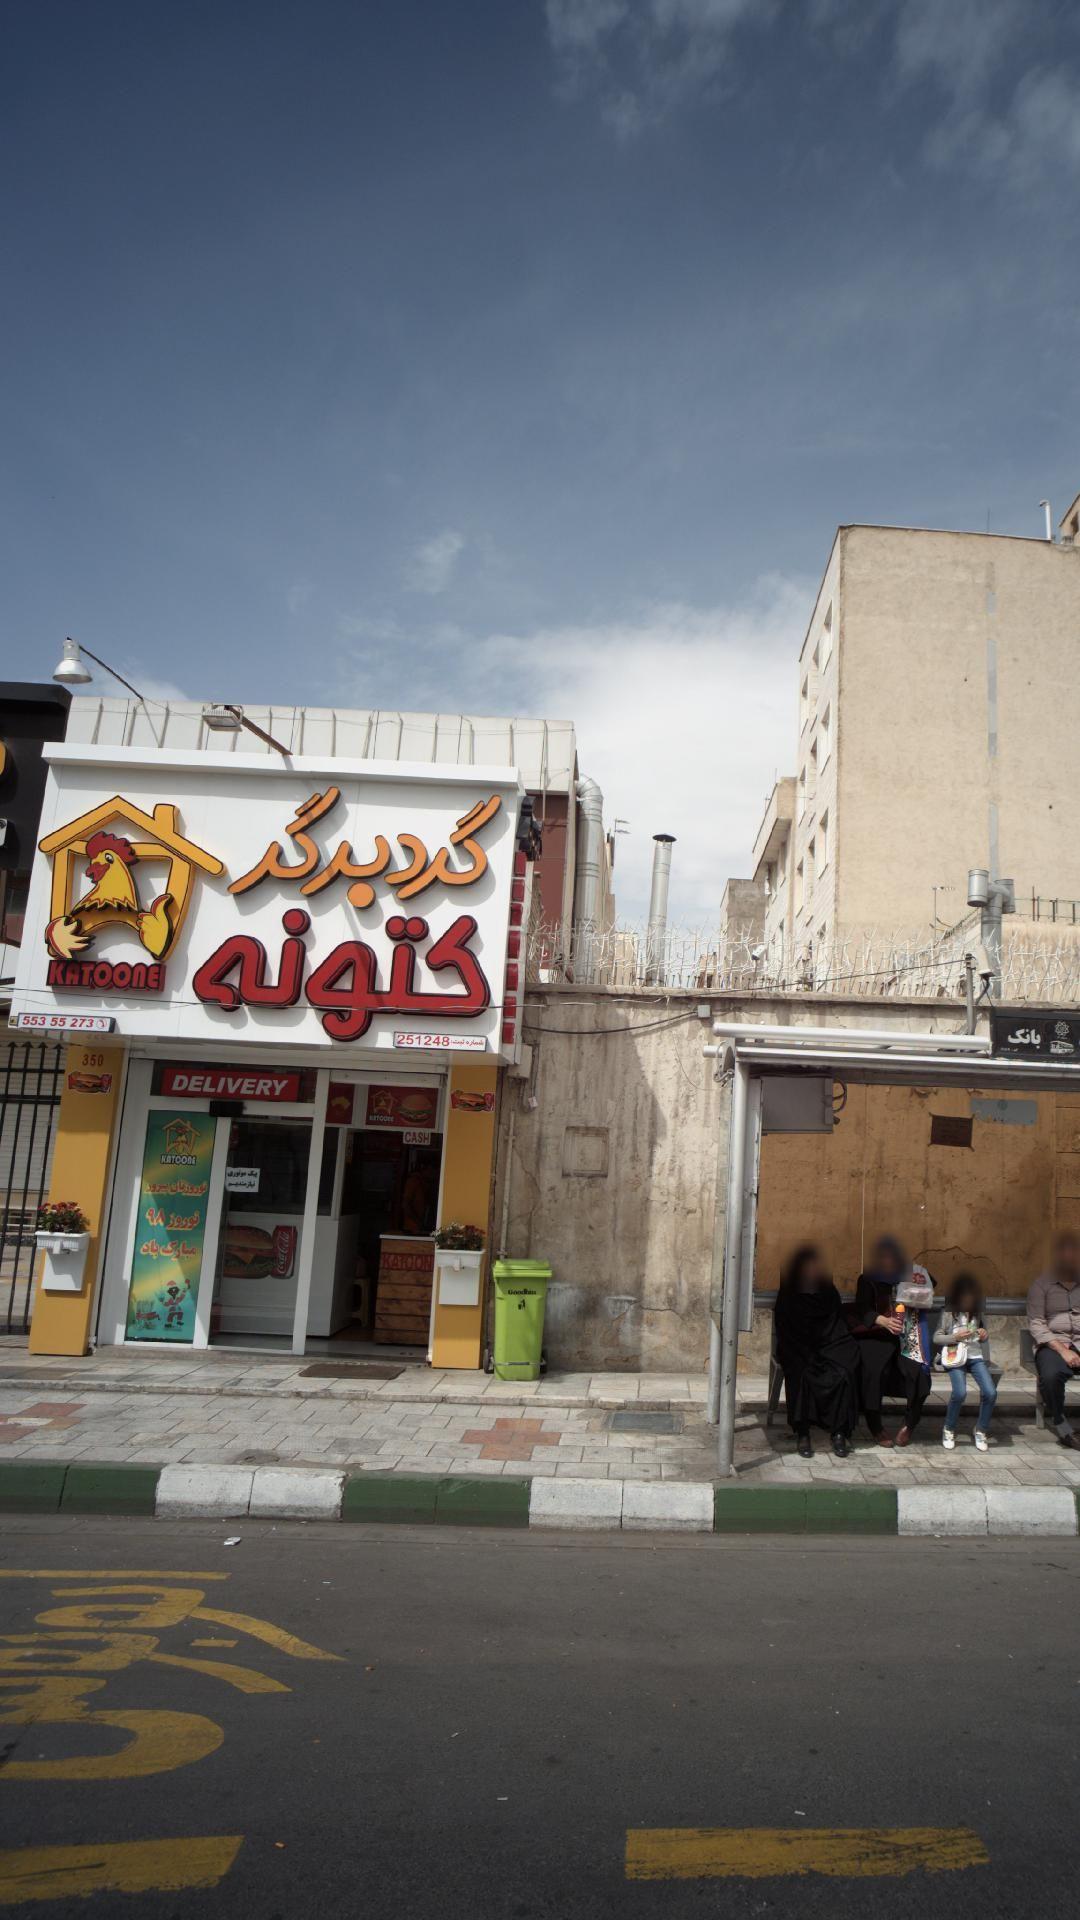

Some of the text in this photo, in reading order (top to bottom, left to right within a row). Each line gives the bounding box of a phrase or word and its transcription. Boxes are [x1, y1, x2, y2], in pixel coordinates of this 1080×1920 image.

[48, 960, 162, 990] KATOONE
[192, 908, 491, 1042] کتونه
[22, 1016, 94, 1028] 553 55 273
[397, 1034, 450, 1047] 251248
[1007, 1028, 1041, 1049] بانک
[172, 1074, 288, 1096] DELIVERY
[405, 1132, 430, 1143] CASH
[166, 1211, 200, 1230] نوروز
[160, 1240, 197, 1262] مبارک
